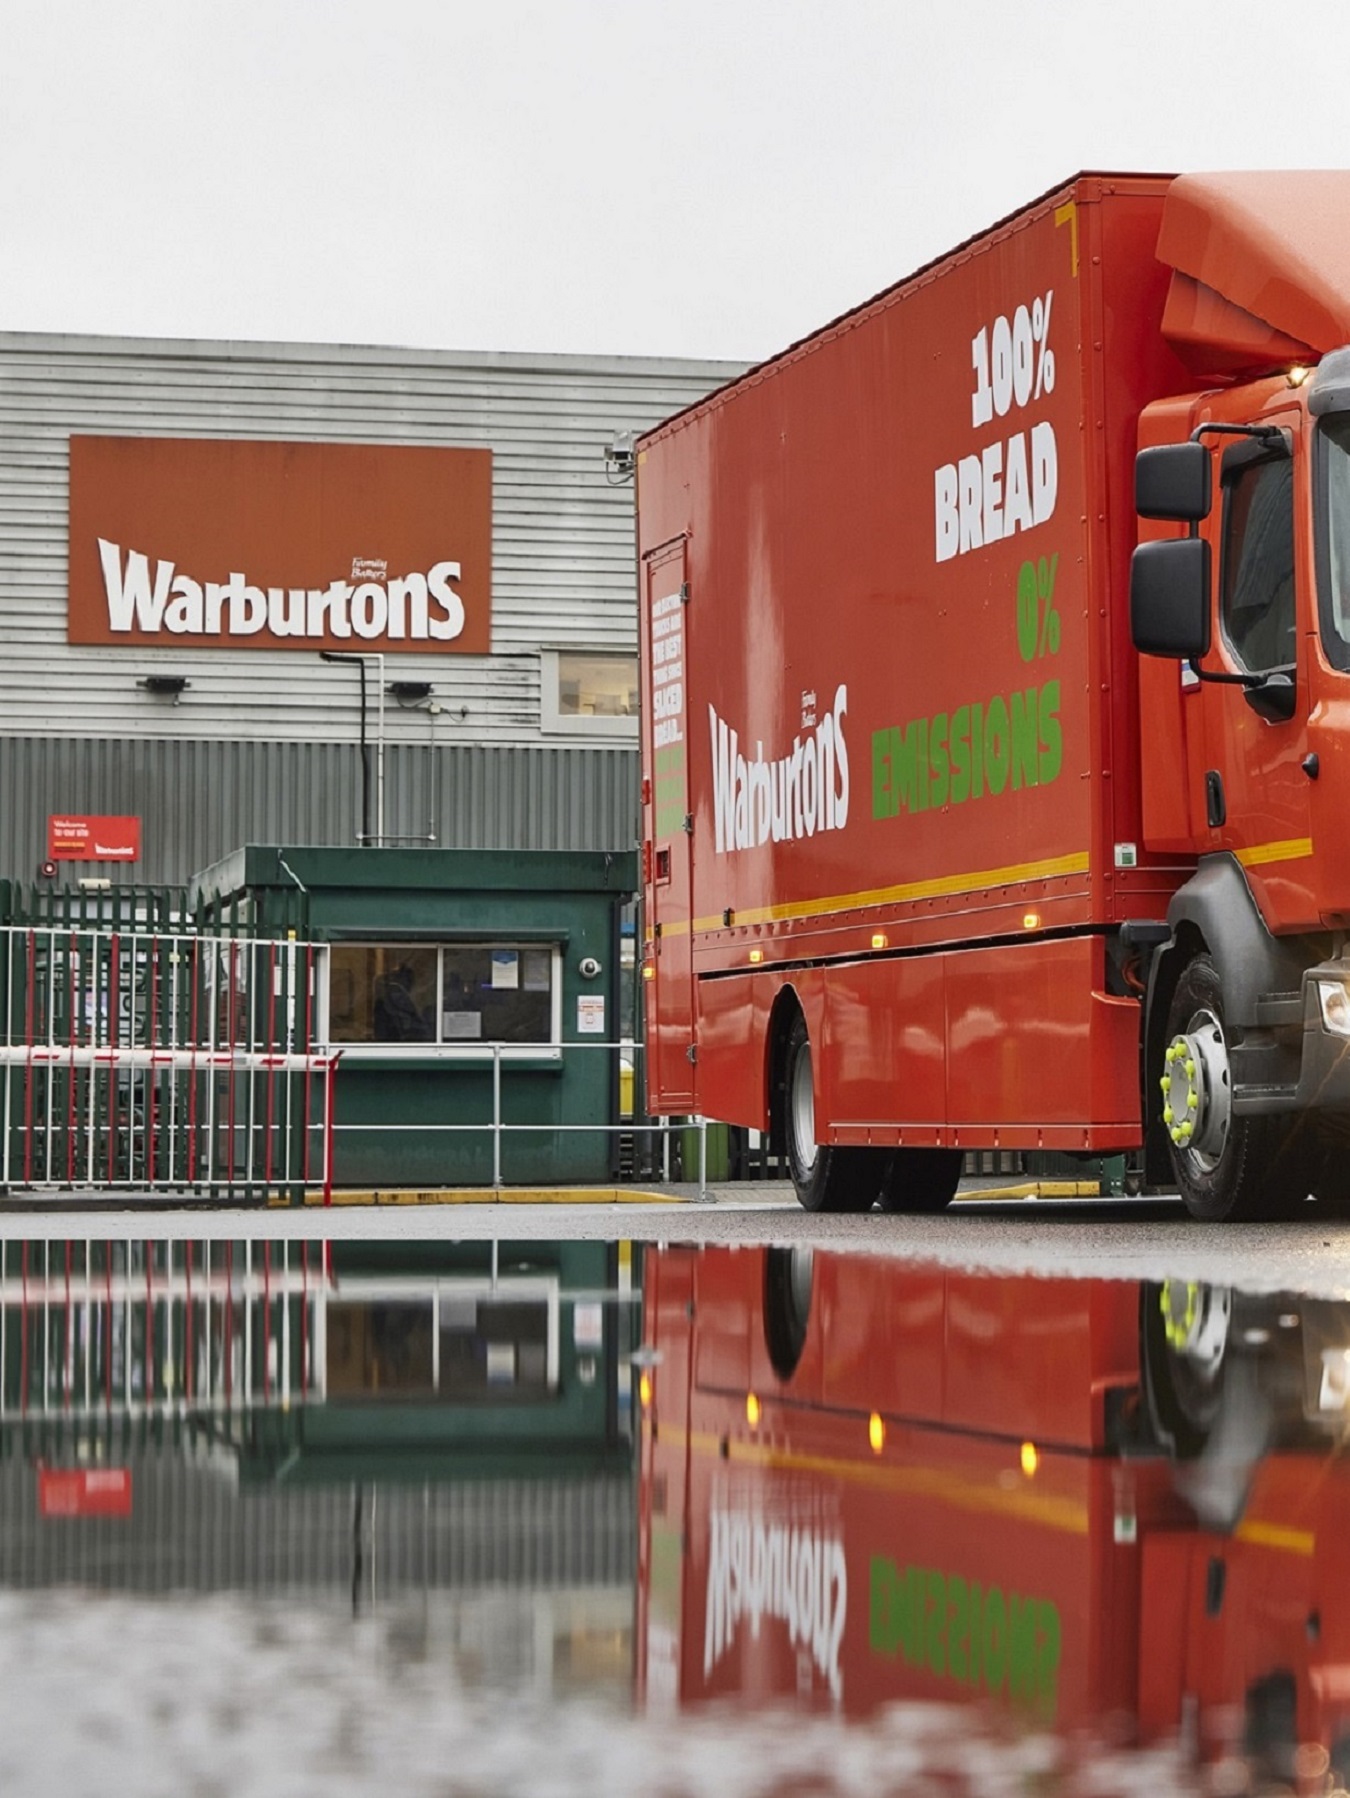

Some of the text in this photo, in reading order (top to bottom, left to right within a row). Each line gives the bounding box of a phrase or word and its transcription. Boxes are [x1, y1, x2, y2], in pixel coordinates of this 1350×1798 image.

[972, 289, 1055, 428] 100%
[934, 420, 1059, 563] BREAD
[97, 537, 465, 640] Warburtons
[1016, 552, 1060, 662] 0%
[708, 684, 850, 854] Warburtons
[871, 679, 1063, 821] EMISSIONS
